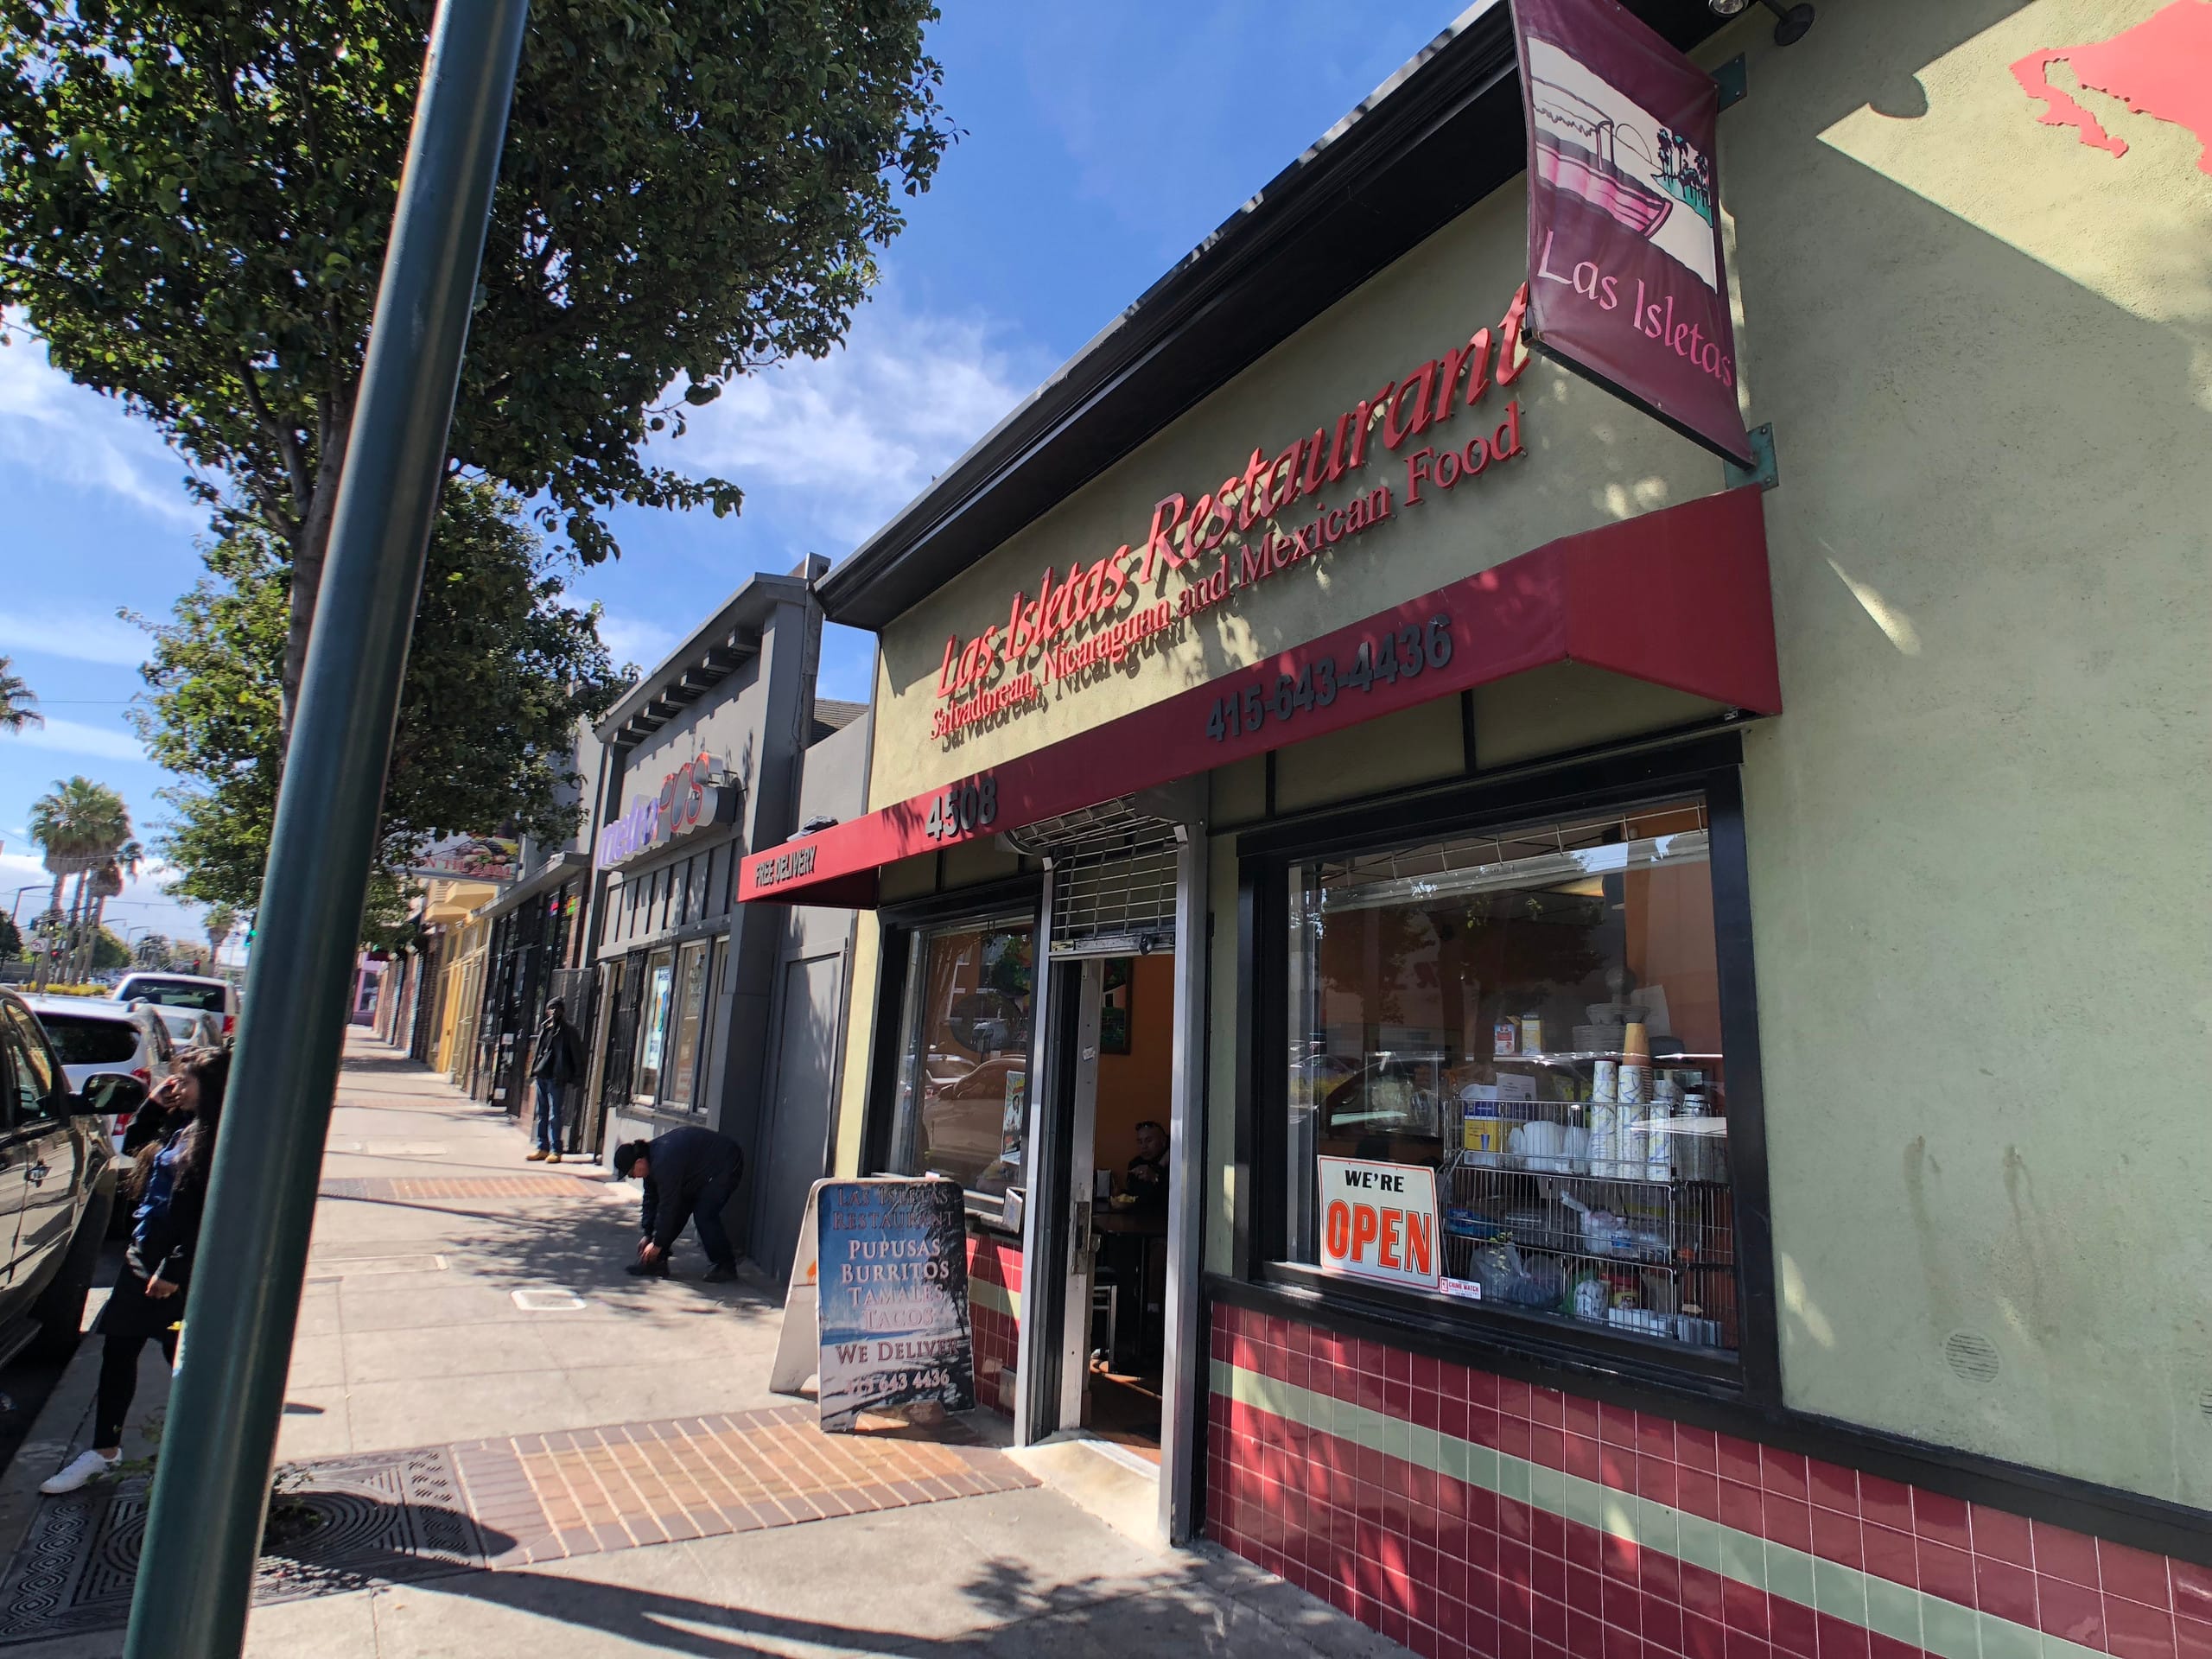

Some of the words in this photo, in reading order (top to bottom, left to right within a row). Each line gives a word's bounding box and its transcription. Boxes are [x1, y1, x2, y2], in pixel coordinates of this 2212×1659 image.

[1537, 226, 1618, 310] Las
[1633, 277, 1732, 387] Isletas
[937, 632, 998, 698] Las
[1004, 543, 1131, 663] Isletas
[1141, 282, 1530, 584] Restaurant
[931, 671, 1038, 741] Salvadorean,
[1042, 598, 1172, 687] Nicaraguan
[1177, 553, 1230, 619] and
[1238, 486, 1392, 588] Mexican
[1403, 400, 1523, 508] Food
[1206, 613, 1452, 741] 415-643-4436
[925, 778, 997, 842] 4508
[755, 859, 774, 888] FREE
[776, 845, 817, 884] DELIVERY
[1344, 1169, 1405, 1193] WE'RE
[837, 1187, 870, 1207] LAS
[833, 1210, 955, 1230] RESTAURANT
[848, 1237, 941, 1262] PUPUSAS
[1326, 1198, 1432, 1276] OPEN
[840, 1260, 950, 1285] BURRITOS
[848, 1283, 944, 1307] TAMALES
[862, 1306, 935, 1330] TACOS
[836, 1343, 868, 1365] WE
[877, 1338, 960, 1363] DELIVER
[843, 1376, 875, 1395] 415
[878, 1372, 908, 1392] 643
[912, 1368, 951, 1390] 4436
